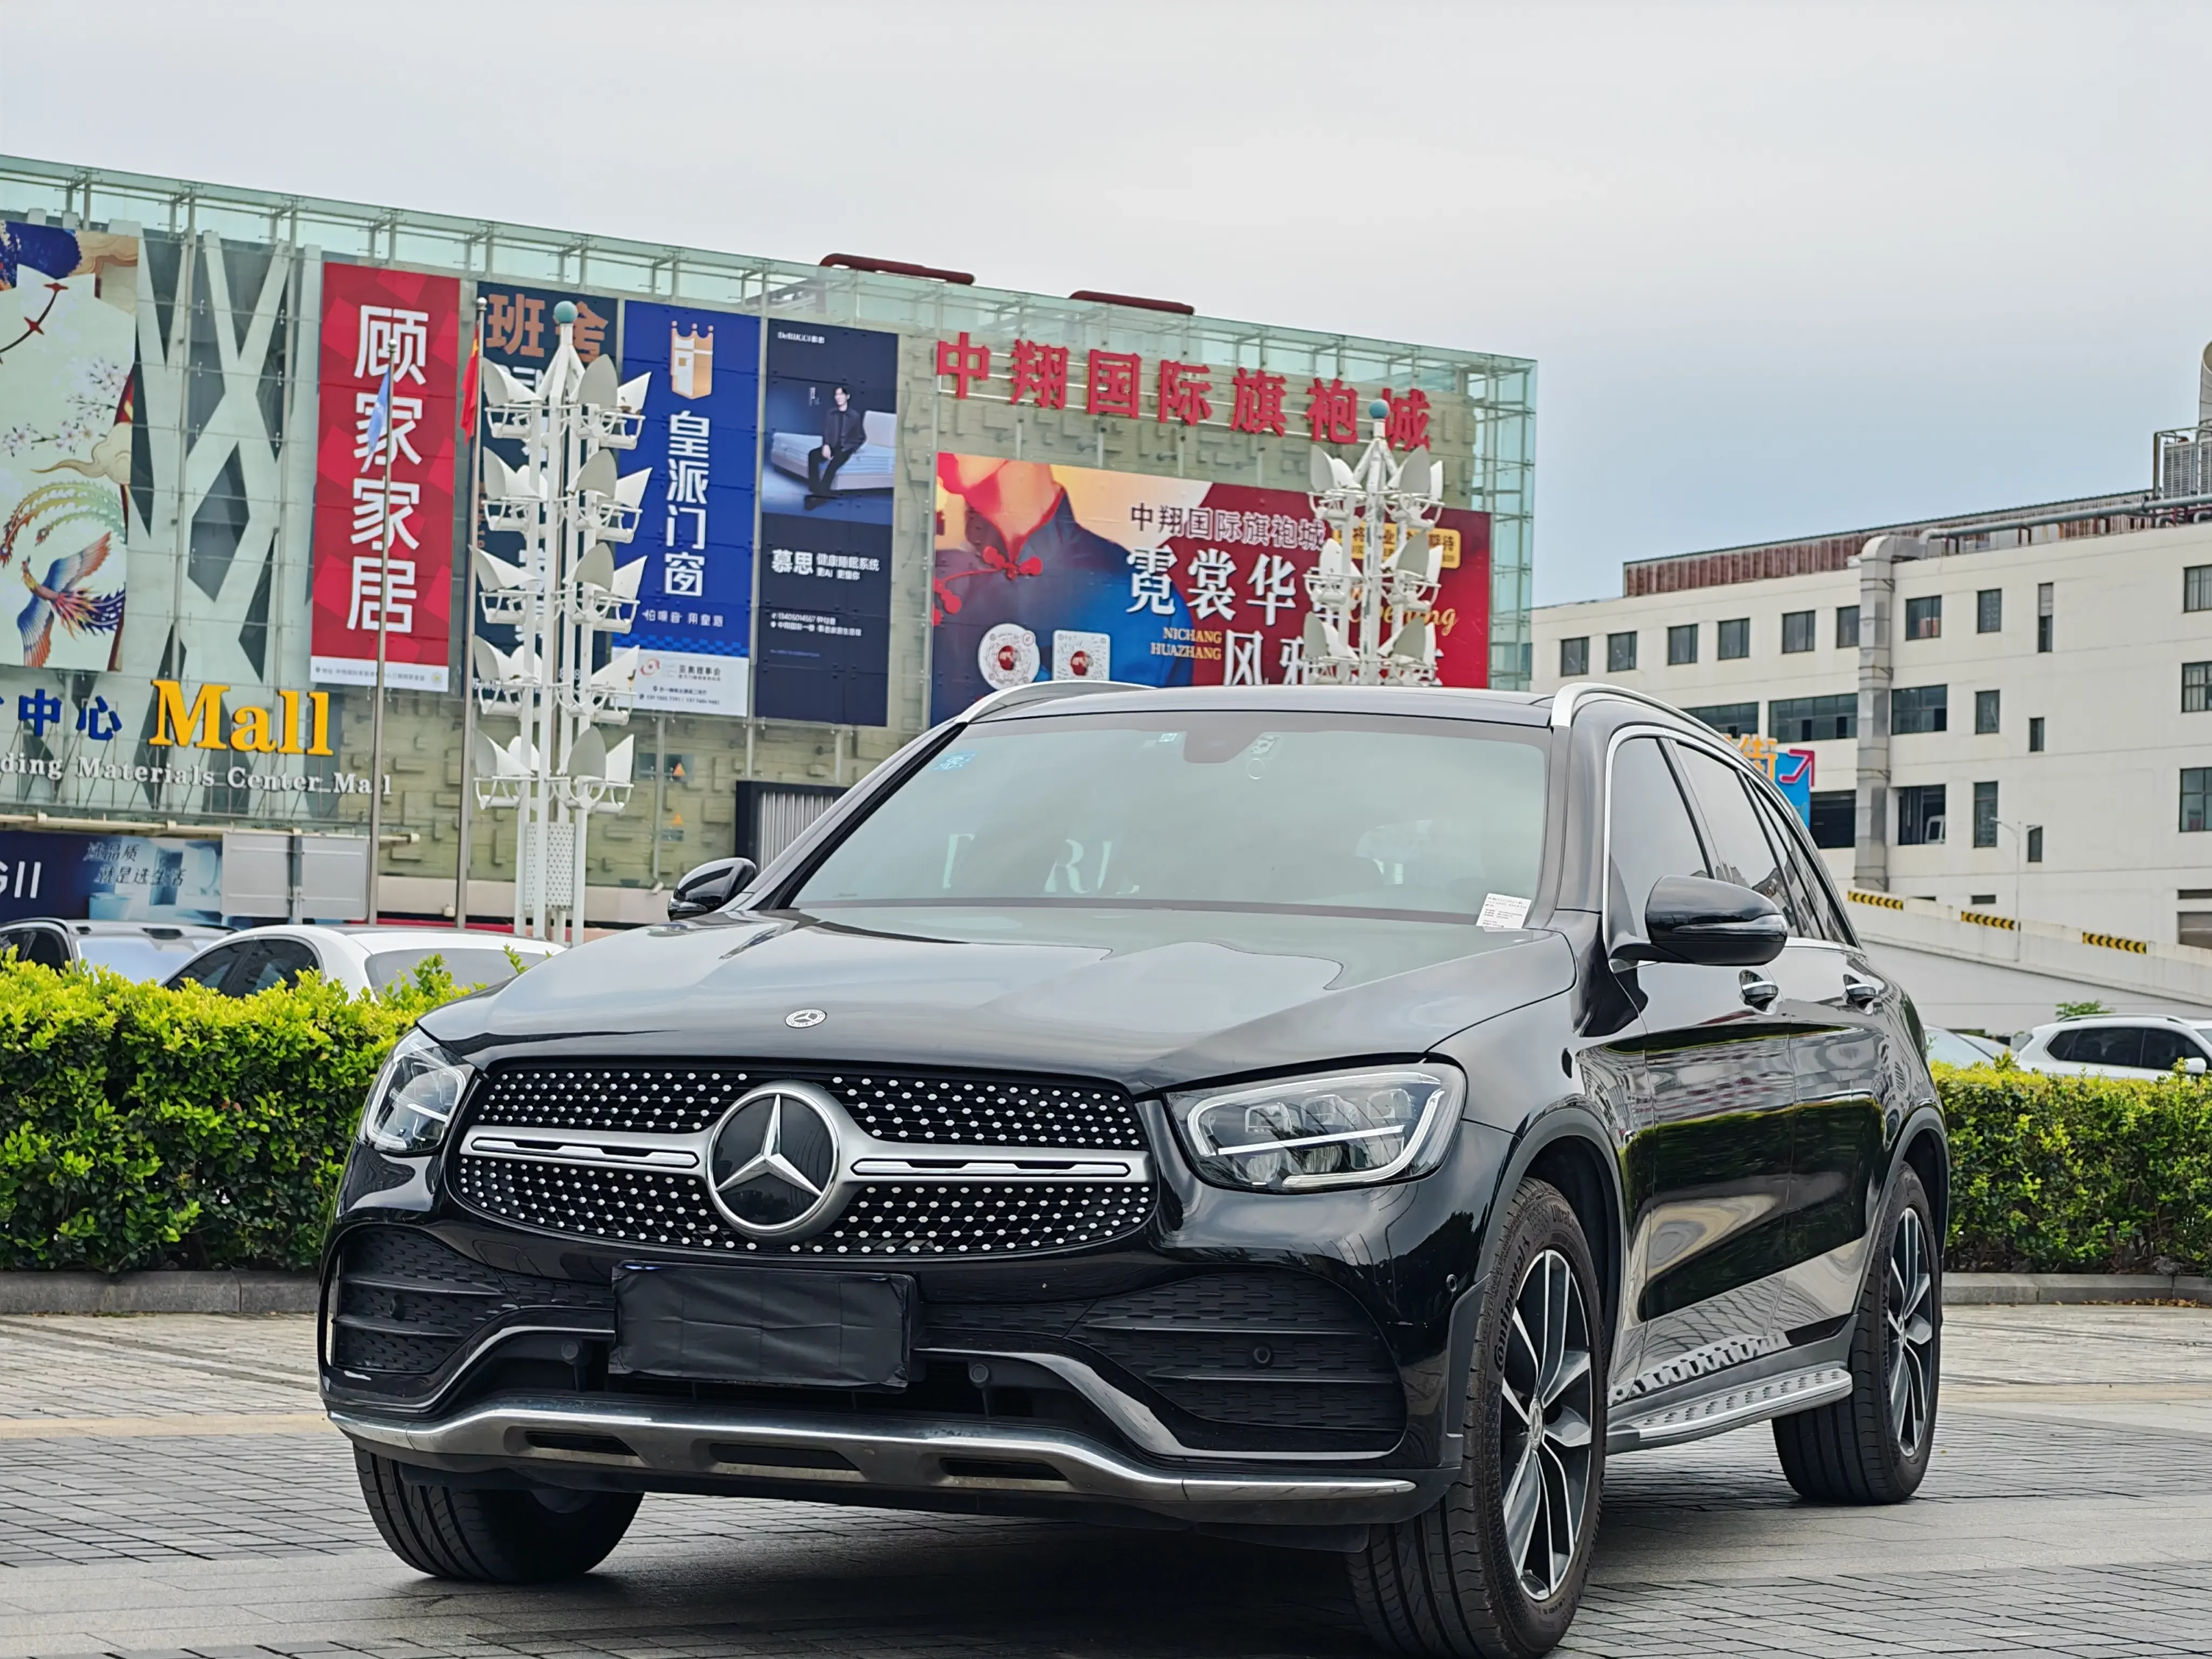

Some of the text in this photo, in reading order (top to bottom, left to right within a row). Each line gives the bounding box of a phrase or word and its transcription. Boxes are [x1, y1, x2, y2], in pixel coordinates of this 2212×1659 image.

[936, 332, 1431, 451] 中翔国际旗袍城
[347, 305, 429, 633] 顾家家居
[665, 410, 710, 596] 皇派门窗
[1131, 502, 1328, 551] 中翔国际旗袍城
[771, 549, 814, 575] 慕思
[1150, 642, 1222, 660] HUAZHANG
[1163, 626, 1223, 644] NICHANG
[0, 679, 334, 756] 中心 Mall
[0, 752, 392, 795] ding Materials Center Mal
